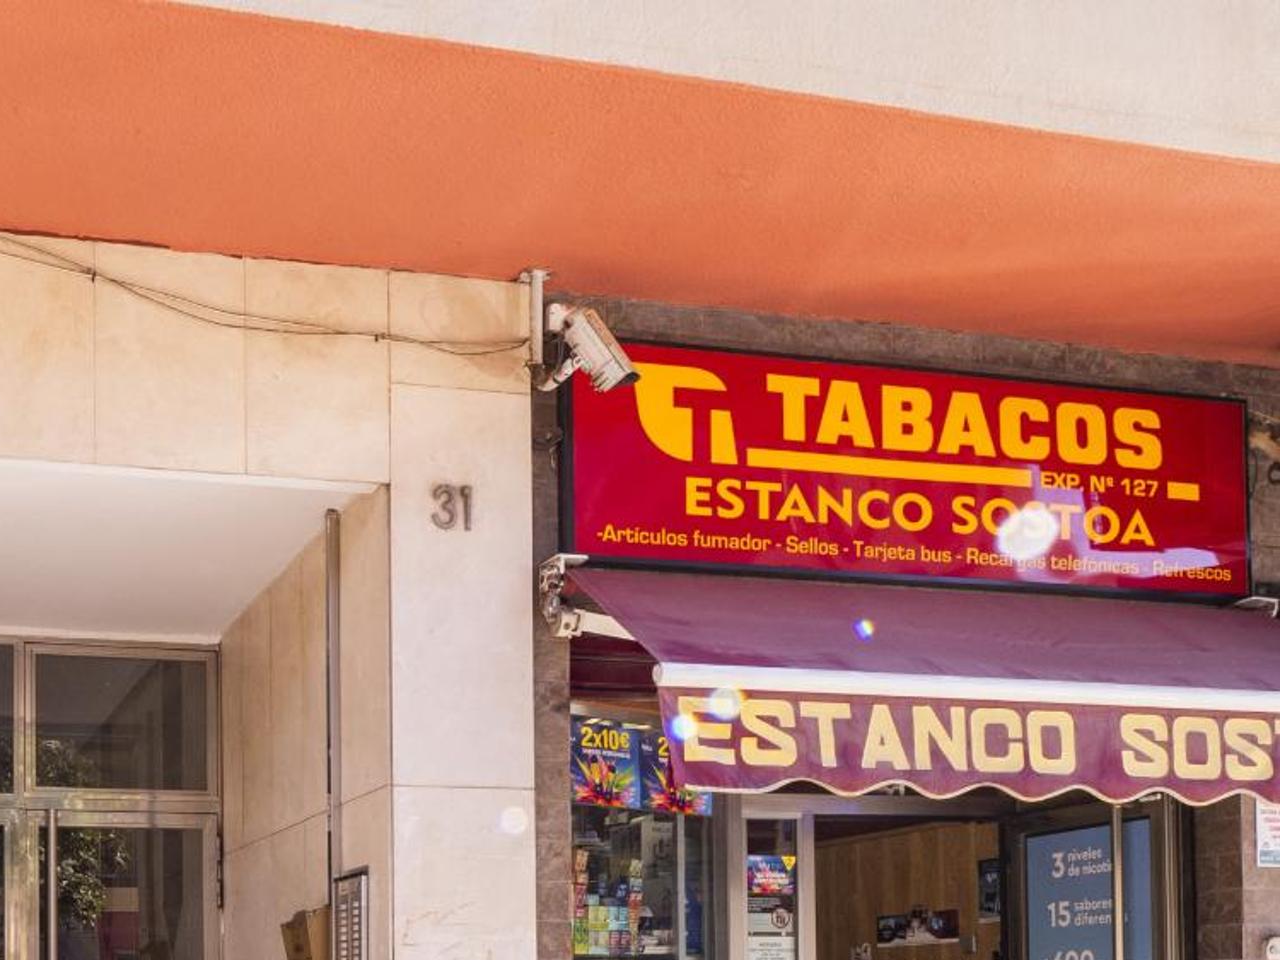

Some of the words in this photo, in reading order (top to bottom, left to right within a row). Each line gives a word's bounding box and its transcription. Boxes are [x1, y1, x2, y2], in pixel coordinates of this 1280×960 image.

[766, 373, 1163, 470] TABACOS
[1121, 478, 1158, 497] 127
[431, 484, 472, 531] 31
[685, 478, 933, 532] ESTANCO
[693, 530, 771, 551] fumador
[786, 535, 839, 555] Sellos
[852, 540, 916, 562] Tarjeta
[921, 545, 952, 563] bus
[581, 726, 630, 751] 2x10€
[678, 695, 1077, 775] ESTANCO
[1120, 713, 1280, 781] SOS
[1051, 851, 1065, 878] 3
[1048, 901, 1071, 928] 15
